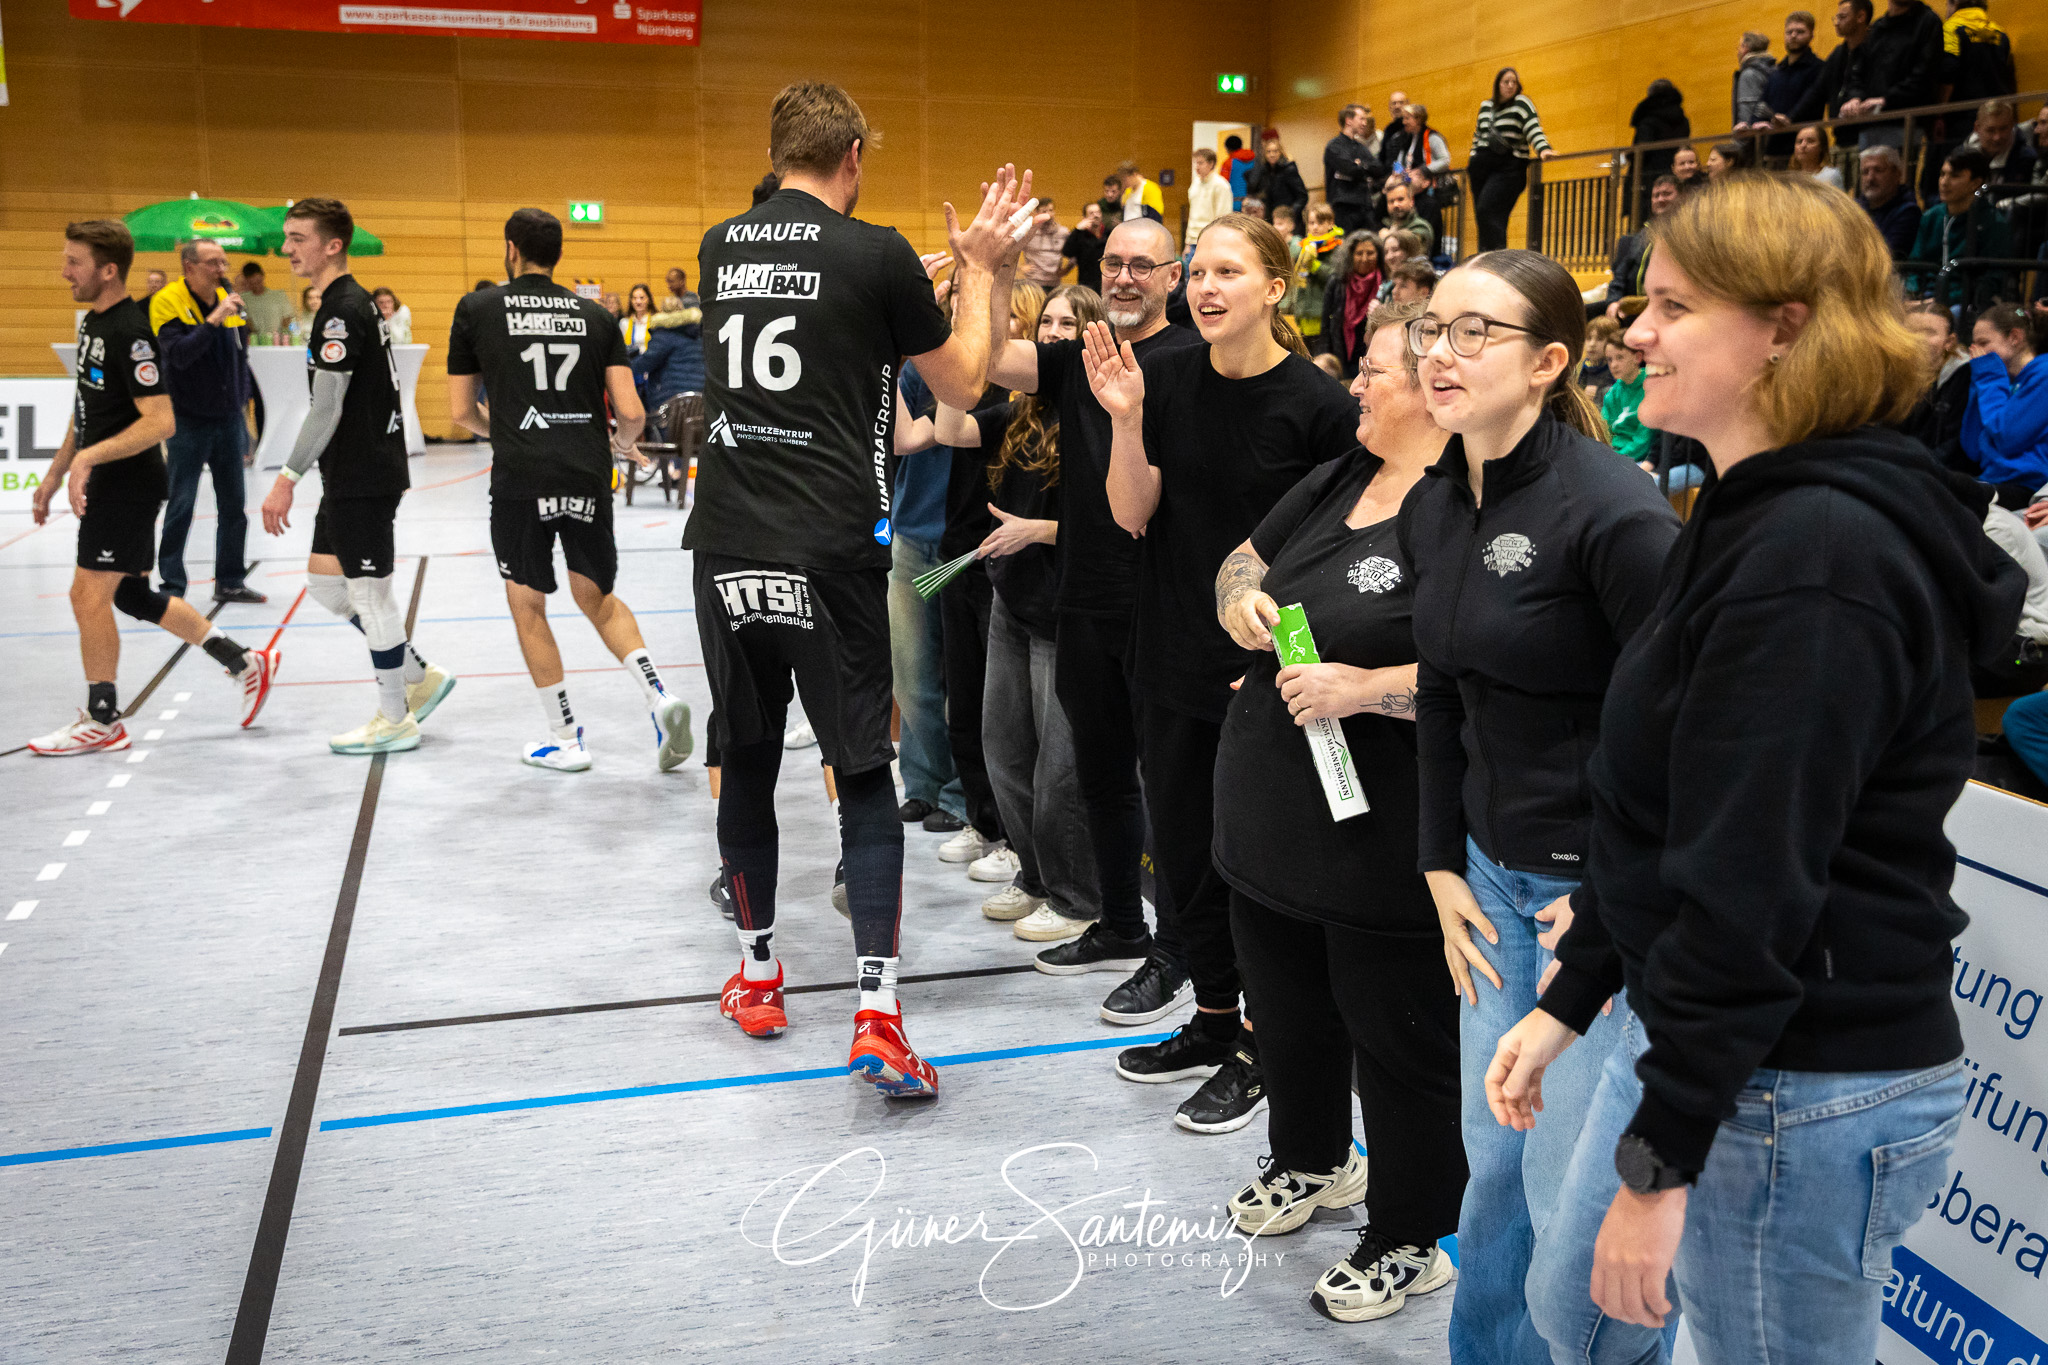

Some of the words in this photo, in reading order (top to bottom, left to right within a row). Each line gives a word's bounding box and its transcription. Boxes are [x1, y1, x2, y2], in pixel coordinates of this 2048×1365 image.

[636, 7, 696, 22] Sparkasse
[637, 23, 694, 40] Nürnberg
[725, 223, 821, 242] KNAUER
[775, 263, 798, 271] GmbH
[717, 263, 775, 293] HART
[770, 274, 817, 296] BAU
[503, 295, 580, 310] MEDURIC
[506, 312, 552, 331] HART
[554, 321, 583, 332] BAU
[718, 314, 802, 391] 16
[520, 343, 581, 391] 17
[874, 364, 891, 512] UMBRAGROUP
[1483, 549, 1532, 568] DIAMONDS
[1347, 568, 1395, 591] DIAMONDS
[716, 579, 797, 617] HTS
[1551, 852, 1580, 861] oxelo
